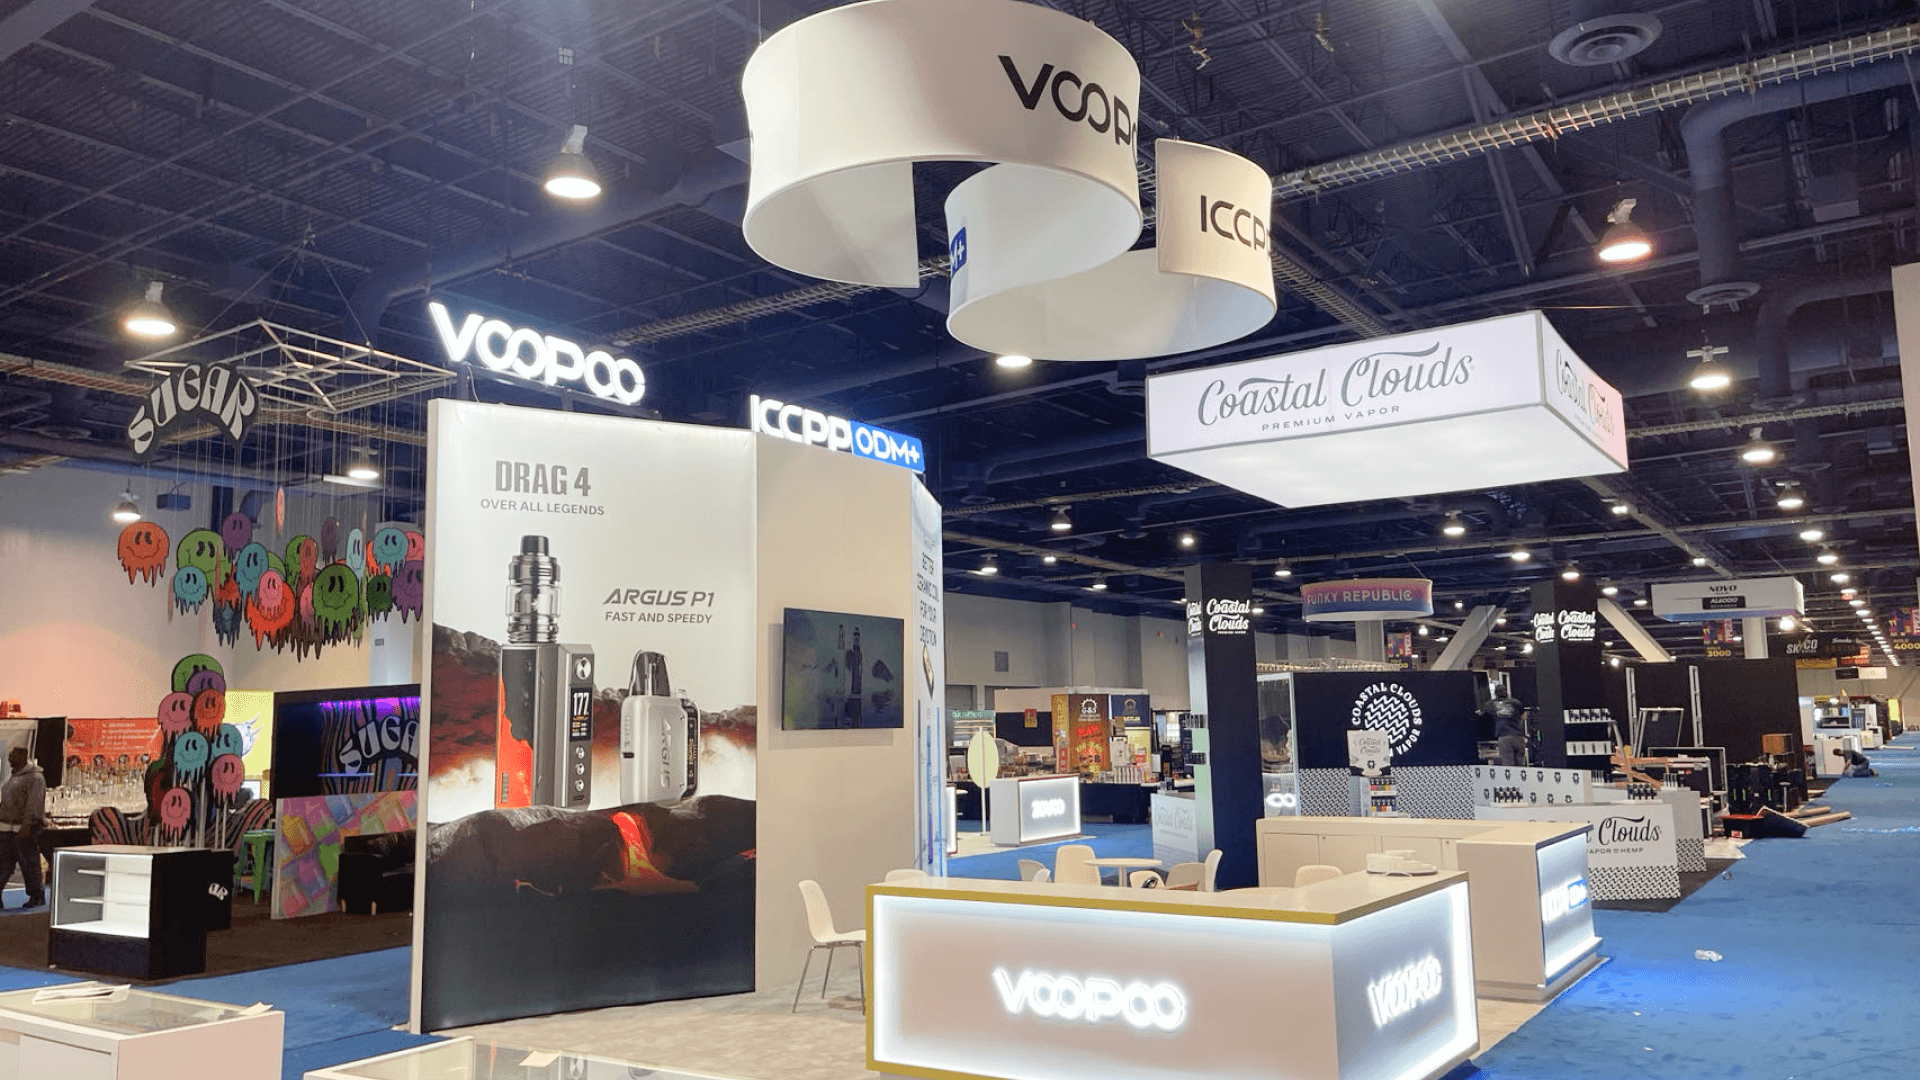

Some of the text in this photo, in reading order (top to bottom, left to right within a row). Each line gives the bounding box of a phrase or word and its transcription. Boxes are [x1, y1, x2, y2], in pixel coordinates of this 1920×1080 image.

[997, 54, 1137, 168] VOOP
[1200, 194, 1269, 256] ICCP
[428, 302, 647, 406] VOOPOO
[1197, 341, 1473, 426] Coastal Clouds
[128, 364, 255, 454] SUGAR
[1261, 405, 1401, 432] PREMIUM VAPOR
[750, 394, 920, 464] ICCPP ODM+
[495, 460, 592, 496] DRAG 4
[480, 499, 605, 516] OVER ALL LEGENDS
[603, 588, 715, 608] ARGUS P1
[1206, 598, 1250, 615] Coastal
[1343, 589, 1413, 602] REPUBLIC
[605, 611, 713, 624] FAST AND SPEEDY
[1209, 613, 1249, 632] Clouds
[1558, 609, 1596, 625] Coastal
[1560, 623, 1595, 639] Clouds
[1351, 682, 1422, 756] COASTAL CLOUDS VAPOR
[1598, 815, 1661, 846] Clouds
[991, 966, 1188, 1031] VOOPOO
